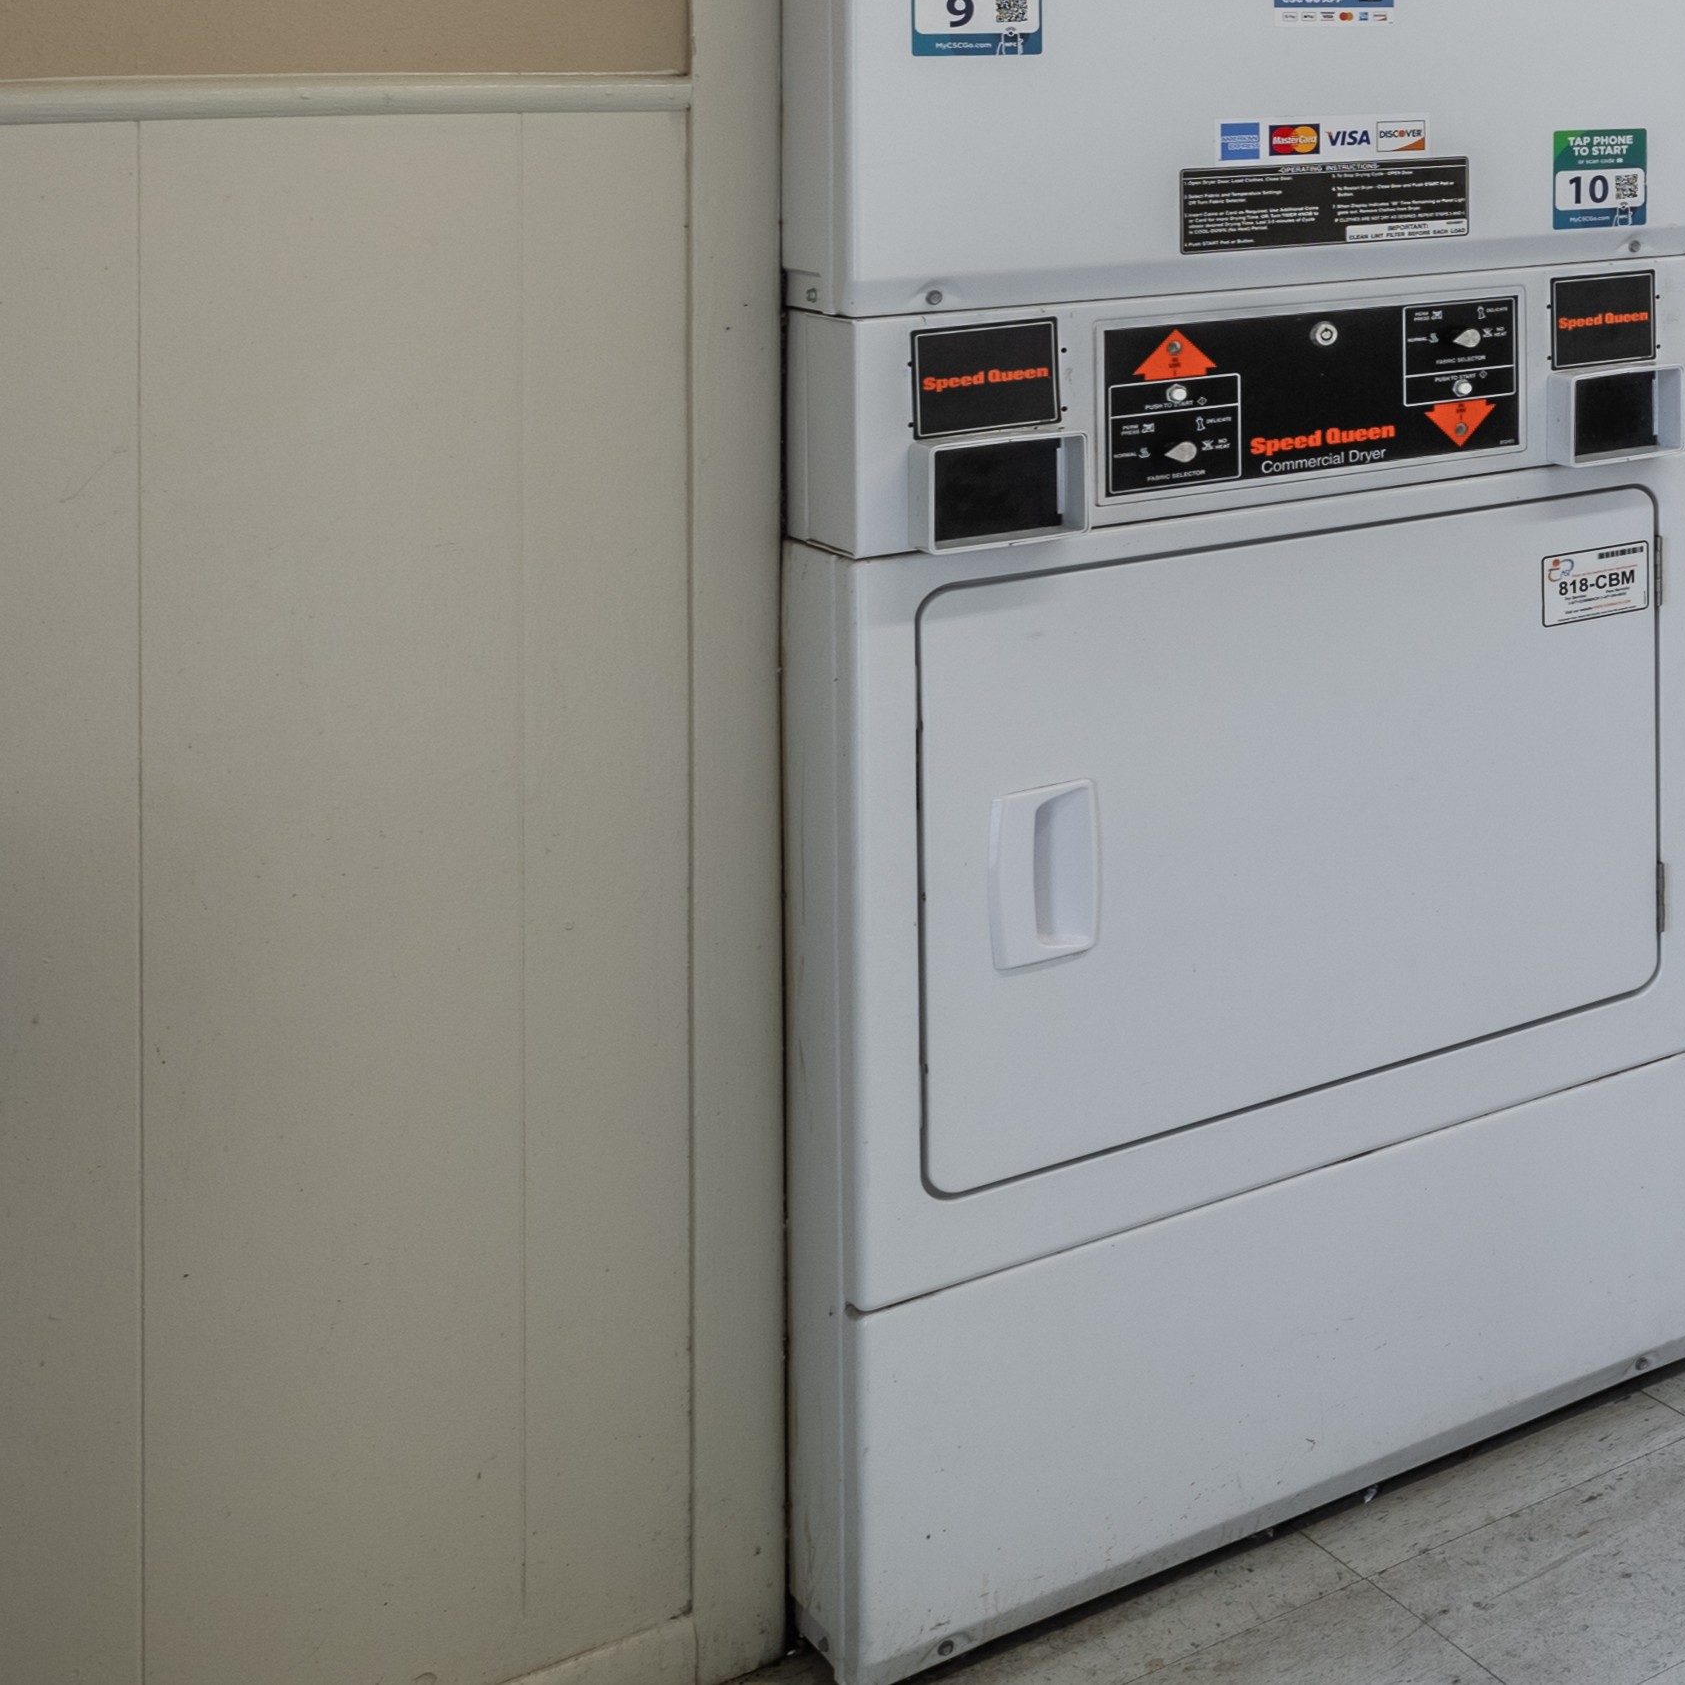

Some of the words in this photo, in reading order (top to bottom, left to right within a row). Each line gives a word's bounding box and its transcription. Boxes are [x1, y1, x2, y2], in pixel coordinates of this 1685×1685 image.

[1325, 130, 1371, 146] VISA
[1380, 129, 1423, 138] DISCOVER
[1272, 135, 1317, 146] MasterCard
[1568, 137, 1591, 146] TAP
[1593, 135, 1633, 145] PHONE
[1573, 147, 1589, 156] TO
[1592, 146, 1628, 155] START
[1569, 175, 1609, 204] 10
[1388, 223, 1428, 231] IMPORTANT:
[1558, 314, 1603, 330] Speed
[1604, 312, 1648, 324] Queen
[1457, 355, 1486, 363] SELECTOR
[923, 371, 985, 392] Speed
[988, 367, 1049, 383] Queen
[1250, 429, 1322, 456] Speed
[1325, 425, 1396, 445] Queen
[1261, 452, 1344, 474] Commercial
[1349, 449, 1386, 463] Dryer
[1172, 470, 1206, 479] SELECTOR
[1559, 569, 1635, 596] 818-CBM
